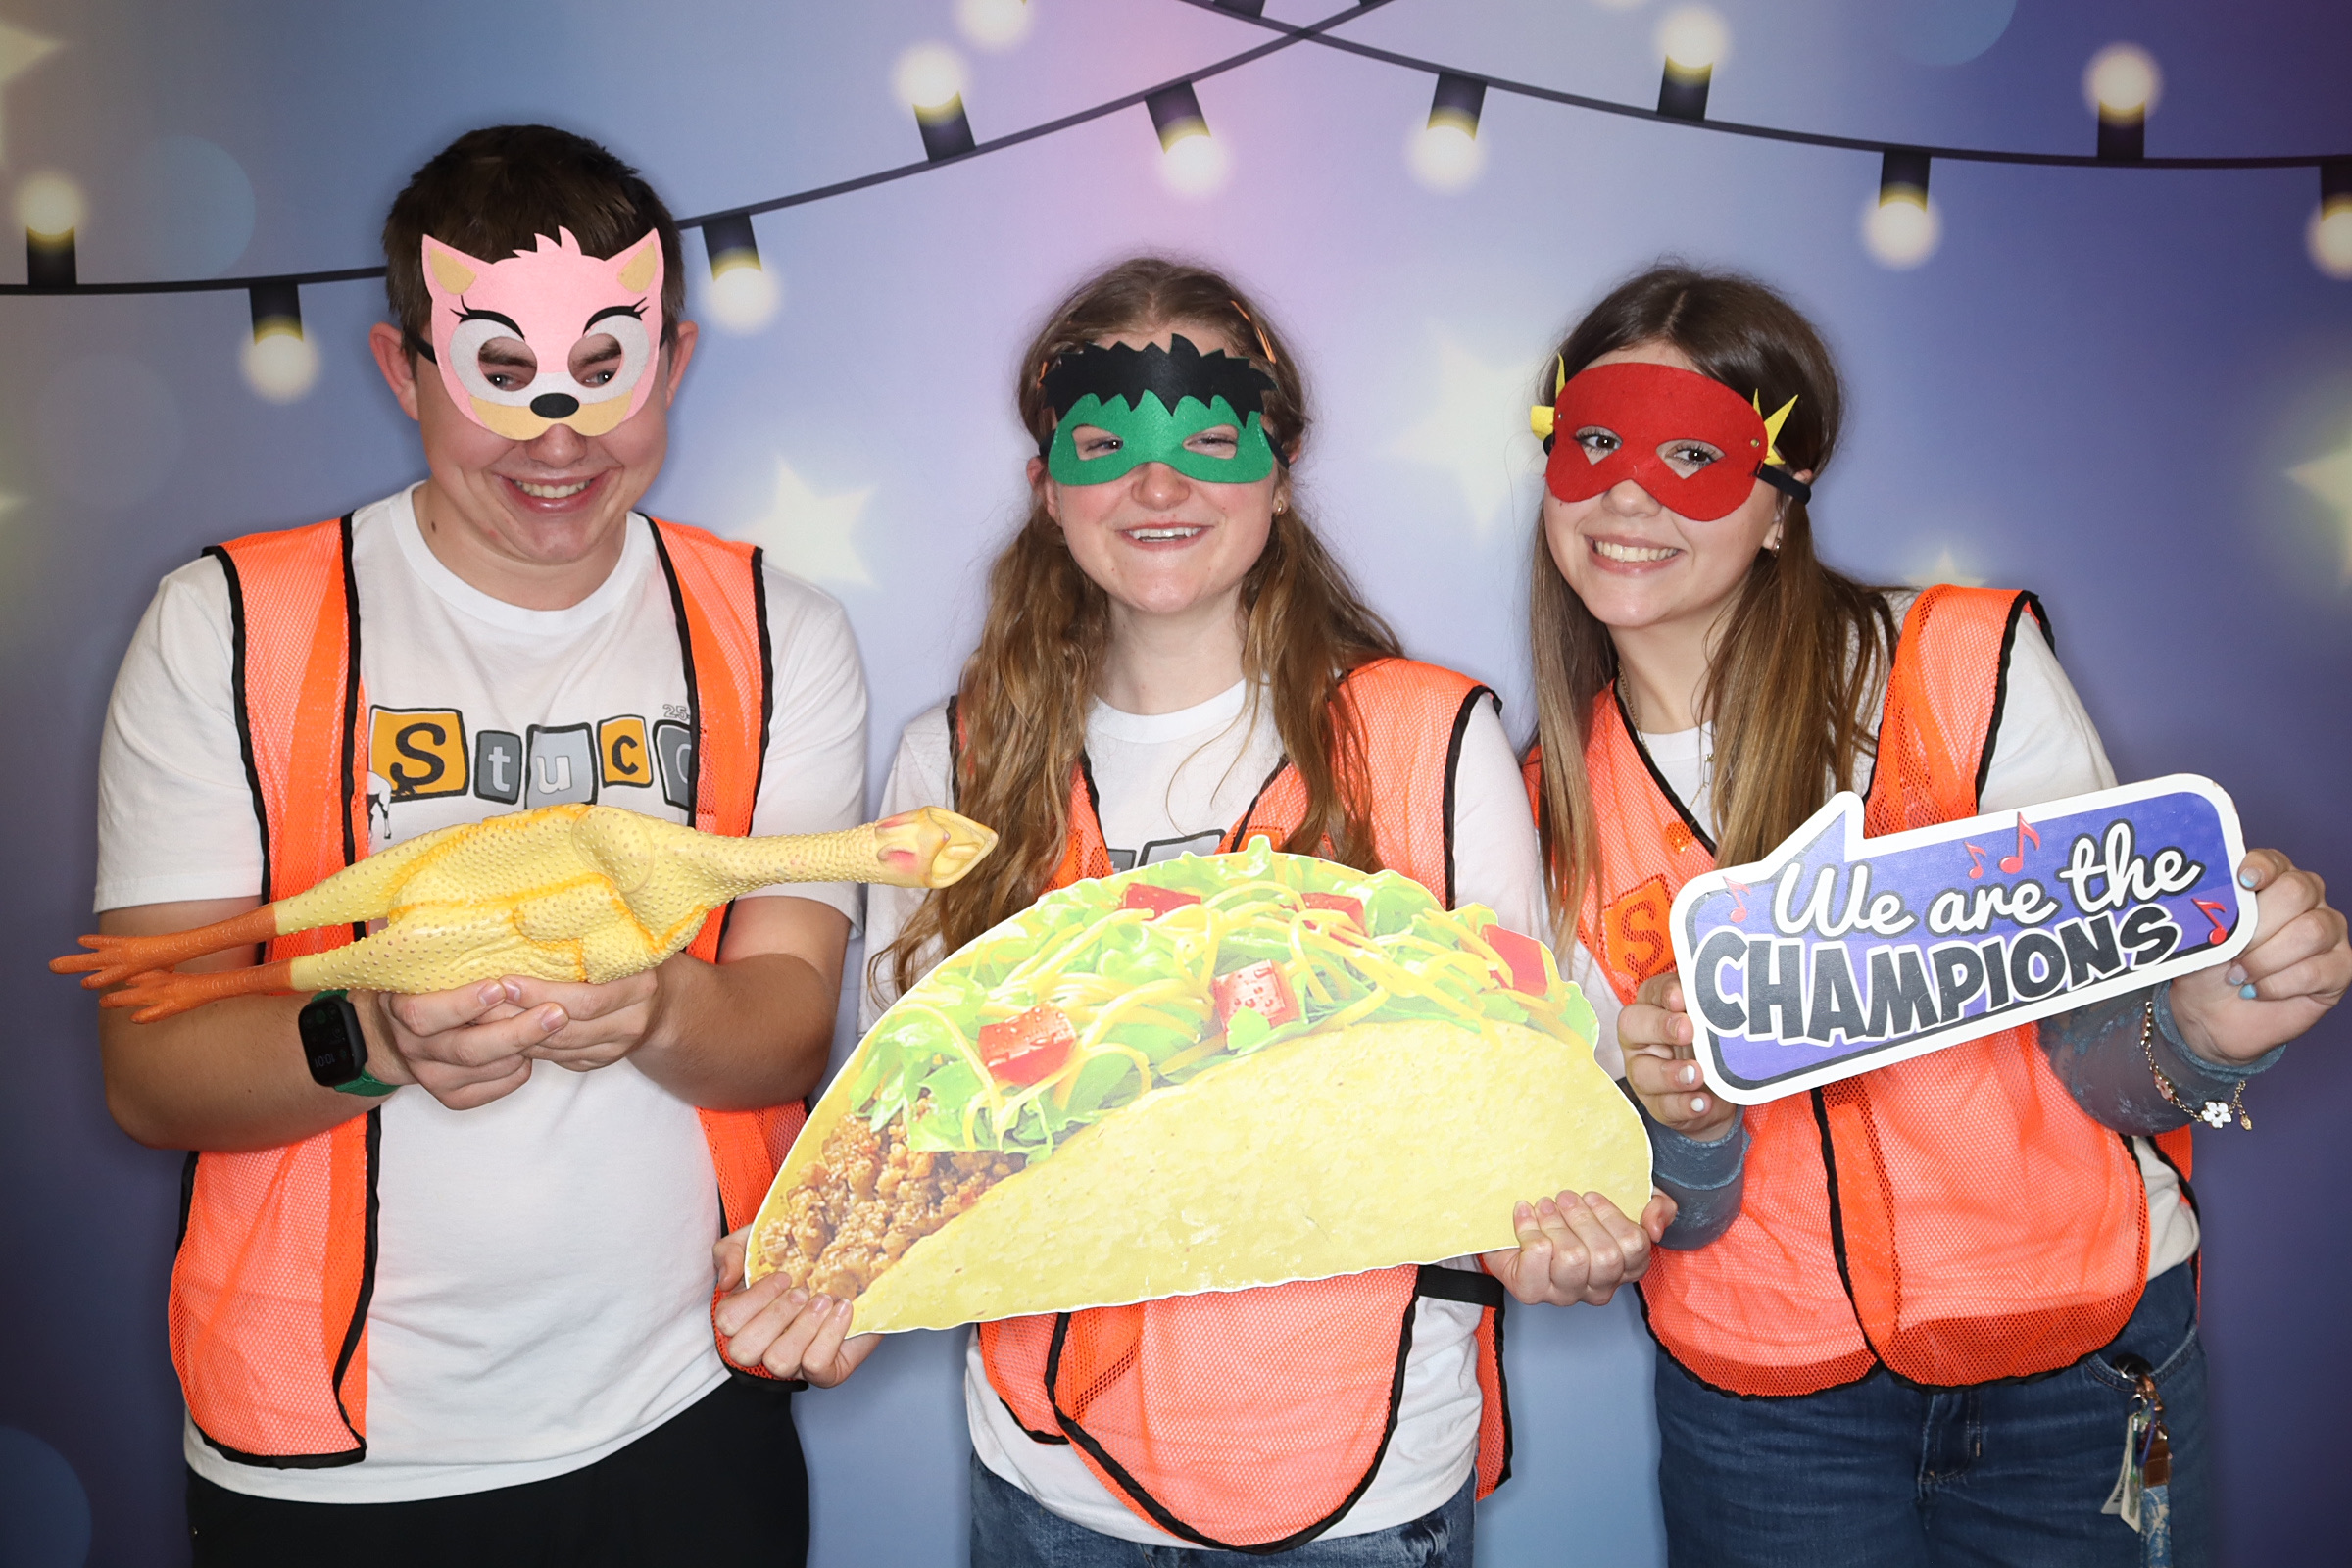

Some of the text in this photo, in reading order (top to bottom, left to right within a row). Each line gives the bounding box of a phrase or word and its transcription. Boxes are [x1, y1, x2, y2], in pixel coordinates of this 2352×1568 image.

[1773, 820, 2200, 938] We are the
[1692, 904, 2182, 1046] CHAMPIONS
